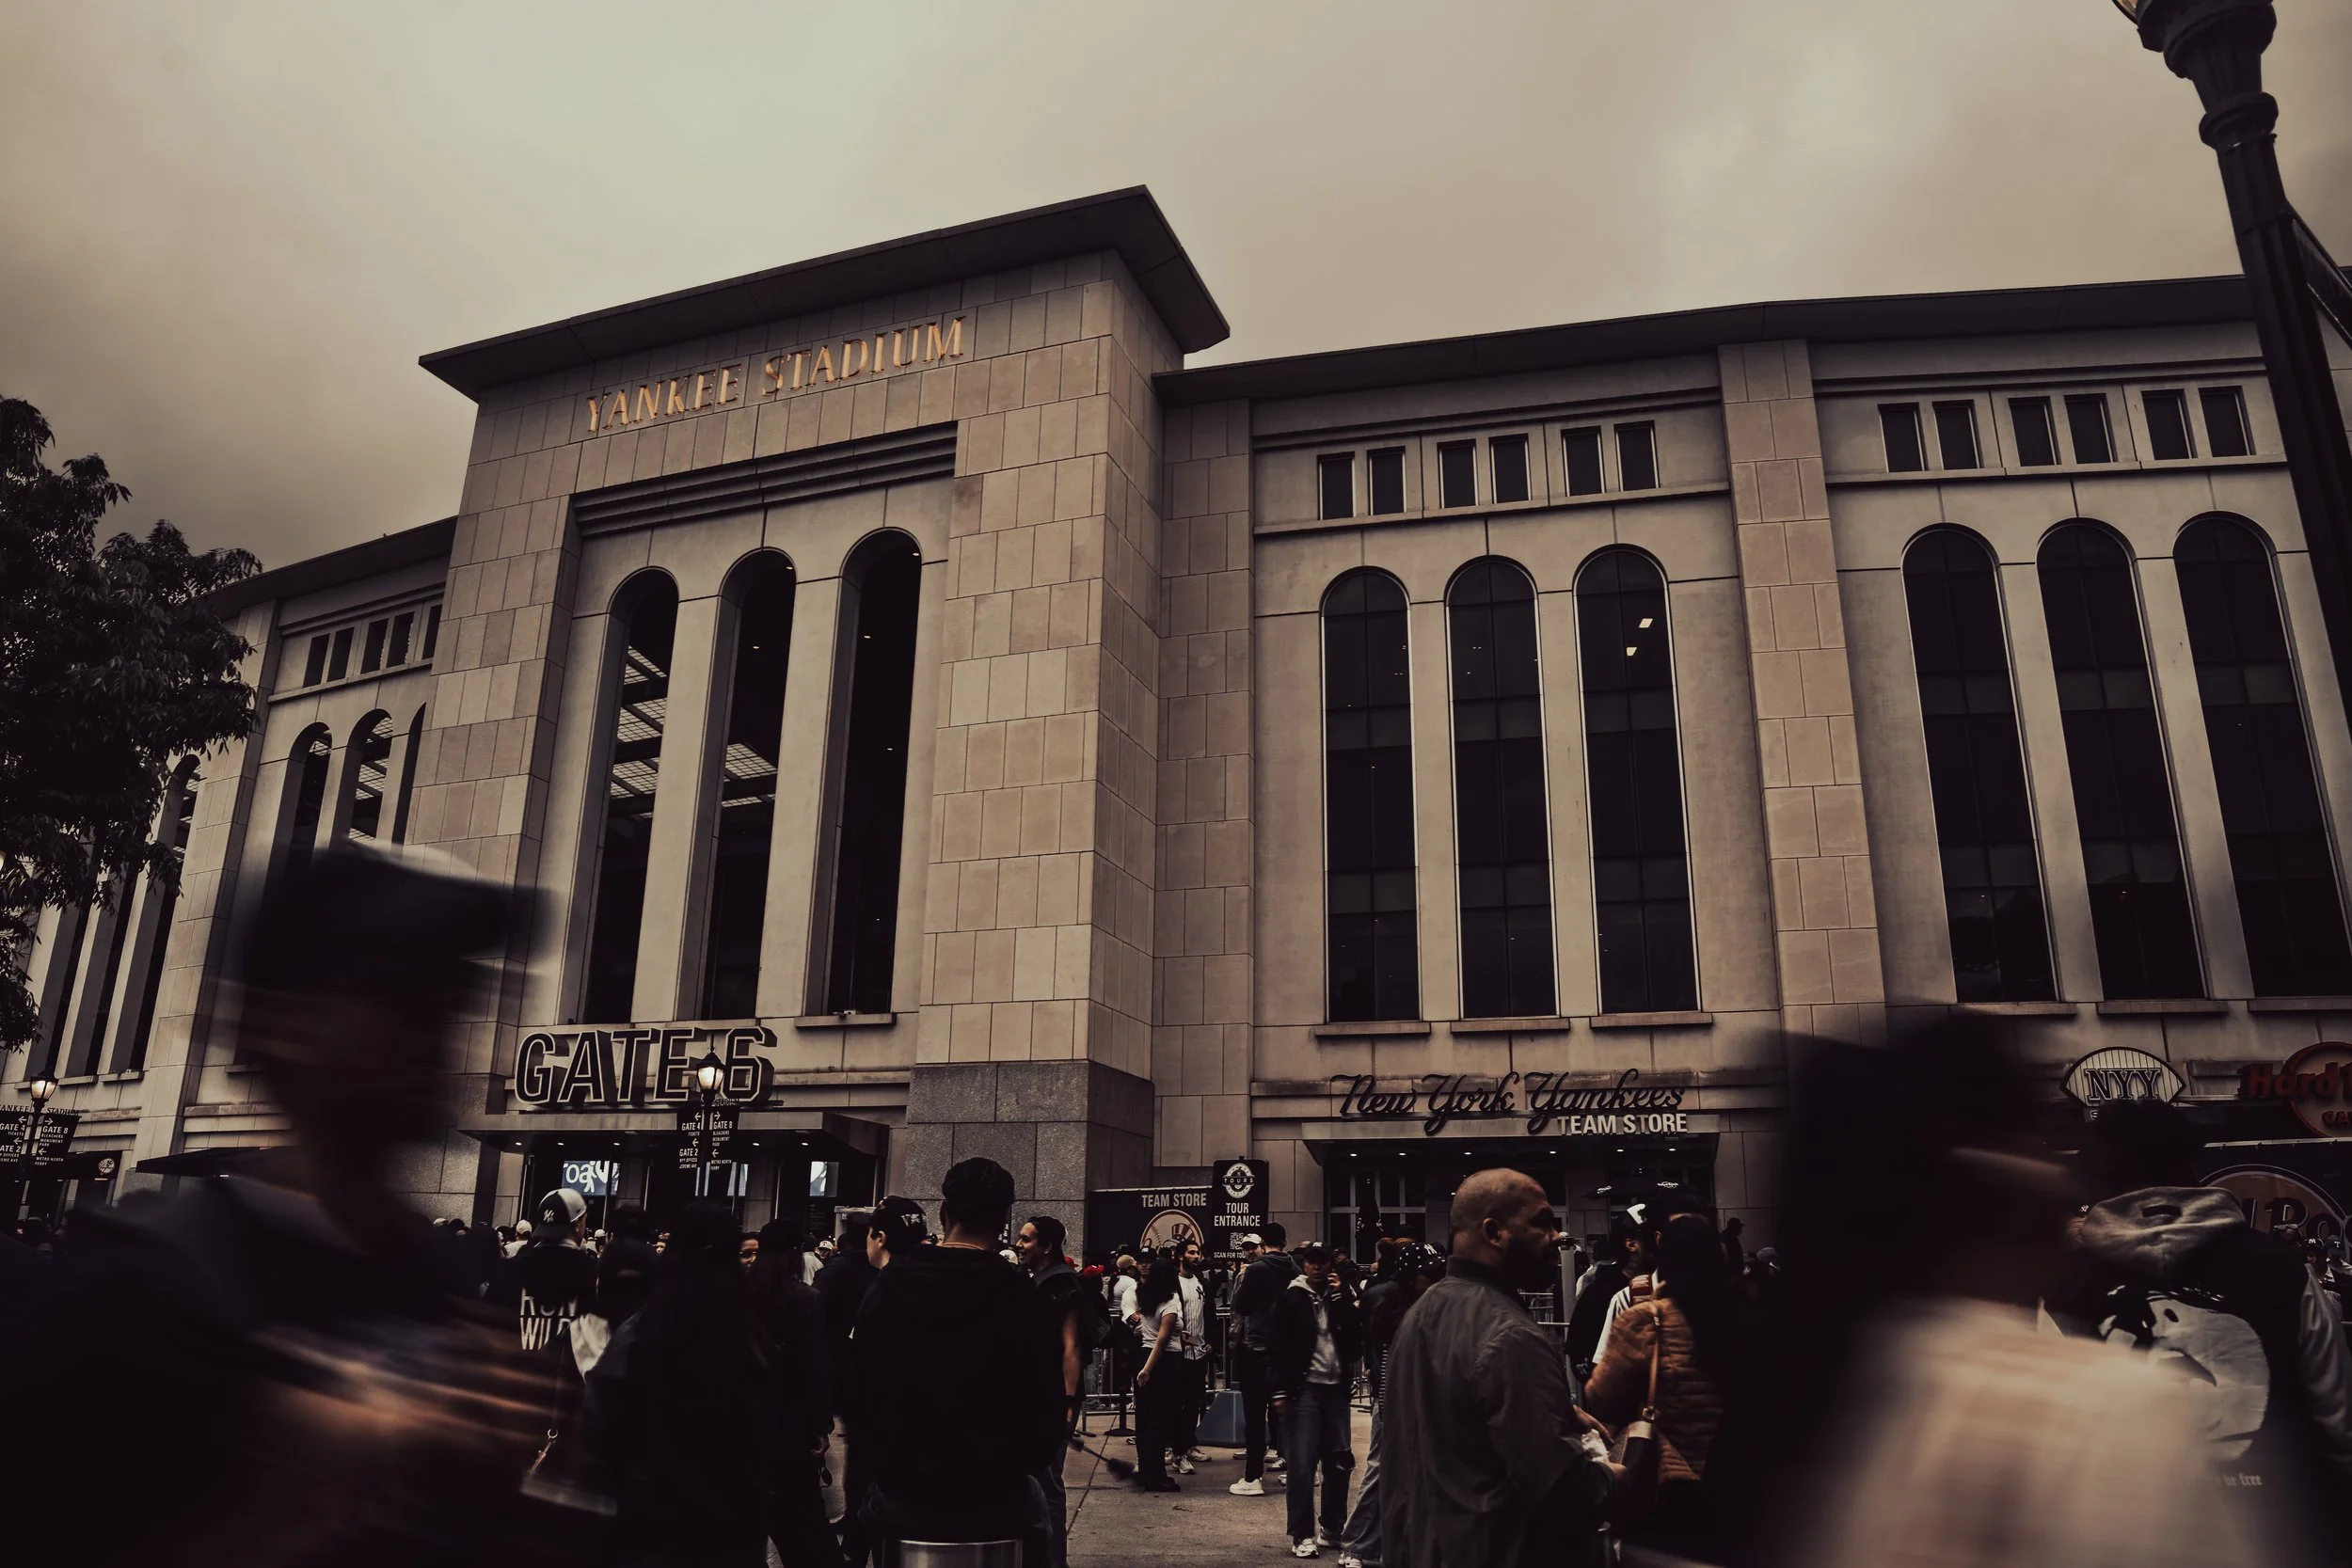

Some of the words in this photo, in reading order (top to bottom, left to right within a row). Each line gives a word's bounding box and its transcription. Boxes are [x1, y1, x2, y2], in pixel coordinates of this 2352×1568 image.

[587, 364, 741, 434] YANKEE
[761, 315, 966, 396] STADIUM
[515, 1026, 704, 1104] GATE
[720, 1025, 777, 1102] 6
[2085, 1068, 2160, 1101] NYY
[2239, 1062, 2339, 1099] Hard
[1330, 1073, 1416, 1117] New
[1422, 1071, 1519, 1136] York
[1524, 1068, 1686, 1135] Yankees
[681, 1122, 696, 1132] GATE
[696, 1122, 701, 1131] 4
[713, 1121, 728, 1130] GATE
[728, 1120, 733, 1130] 8
[1557, 1114, 1617, 1135] TEAM
[1623, 1113, 1688, 1134] STORE
[679, 1148, 693, 1157] GATE
[694, 1148, 698, 1157] 2
[1141, 1194, 1169, 1208] TEAM
[1173, 1193, 1207, 1207] STORE
[1226, 1202, 1249, 1213] TOUR
[1214, 1214, 1261, 1227] ENTRANCE
